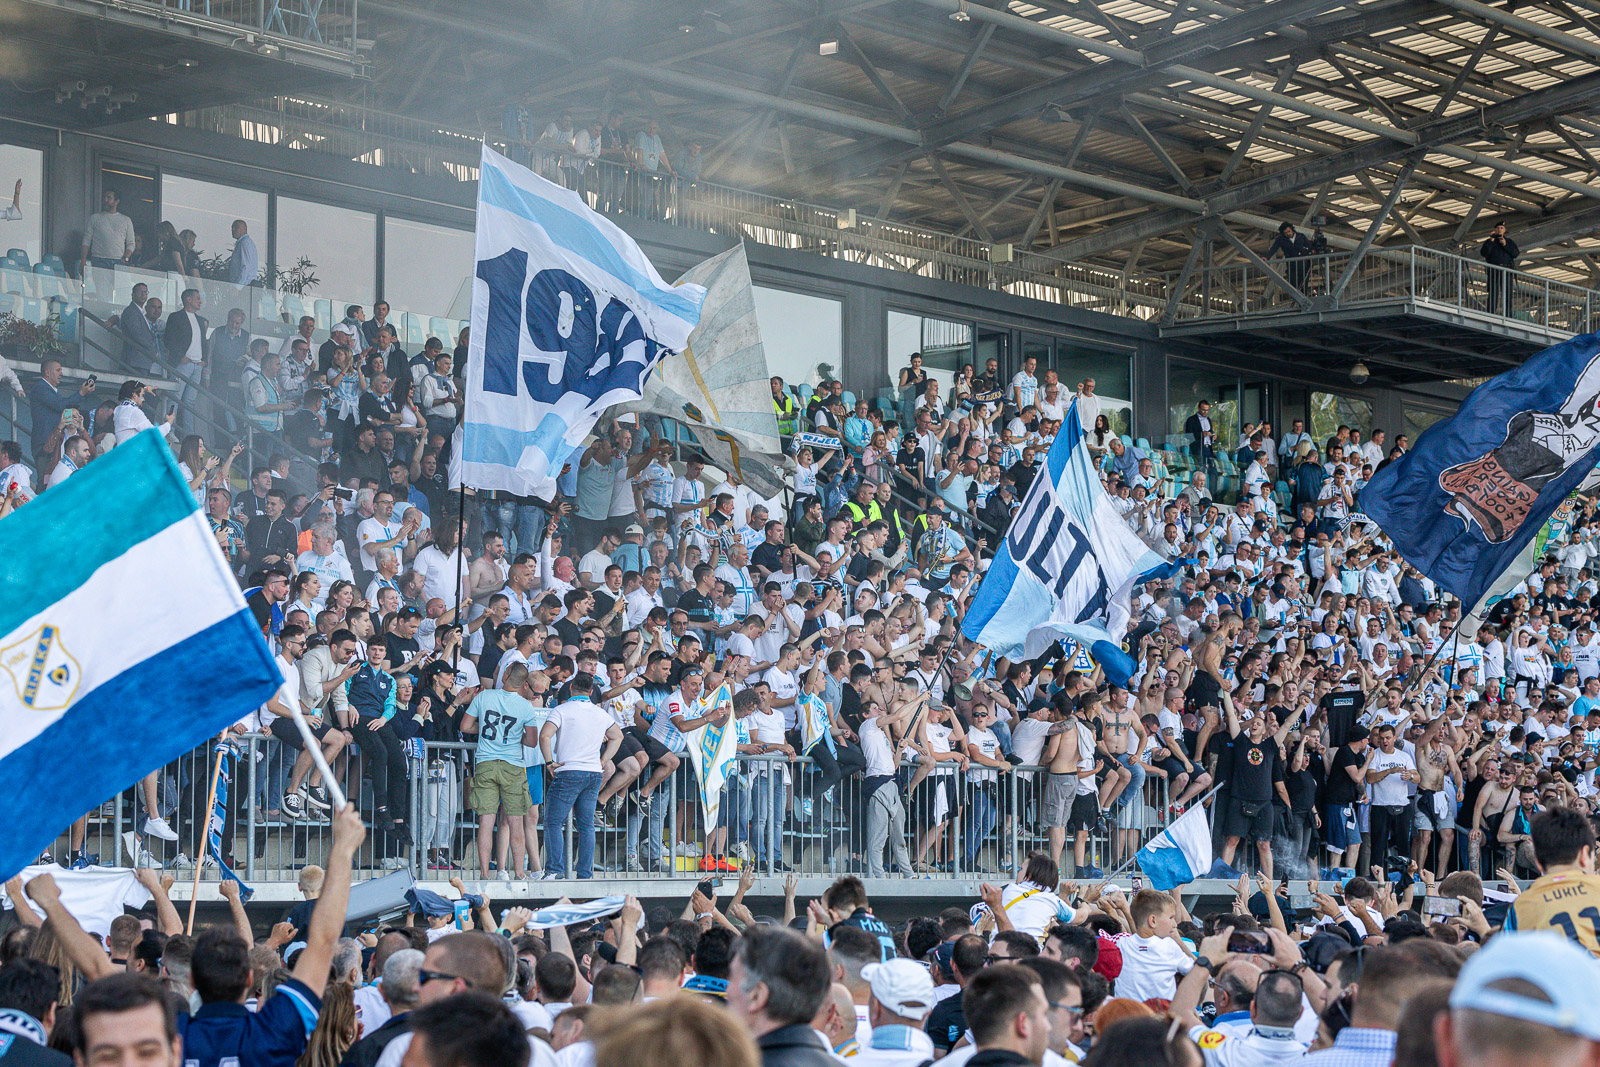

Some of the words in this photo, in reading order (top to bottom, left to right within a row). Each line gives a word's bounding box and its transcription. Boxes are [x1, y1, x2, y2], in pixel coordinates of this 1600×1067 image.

[24, 637, 51, 698] RIJEKA
[481, 709, 518, 745] 87
[1543, 882, 1588, 902] LUKIĆ
[859, 919, 888, 933] MAX
